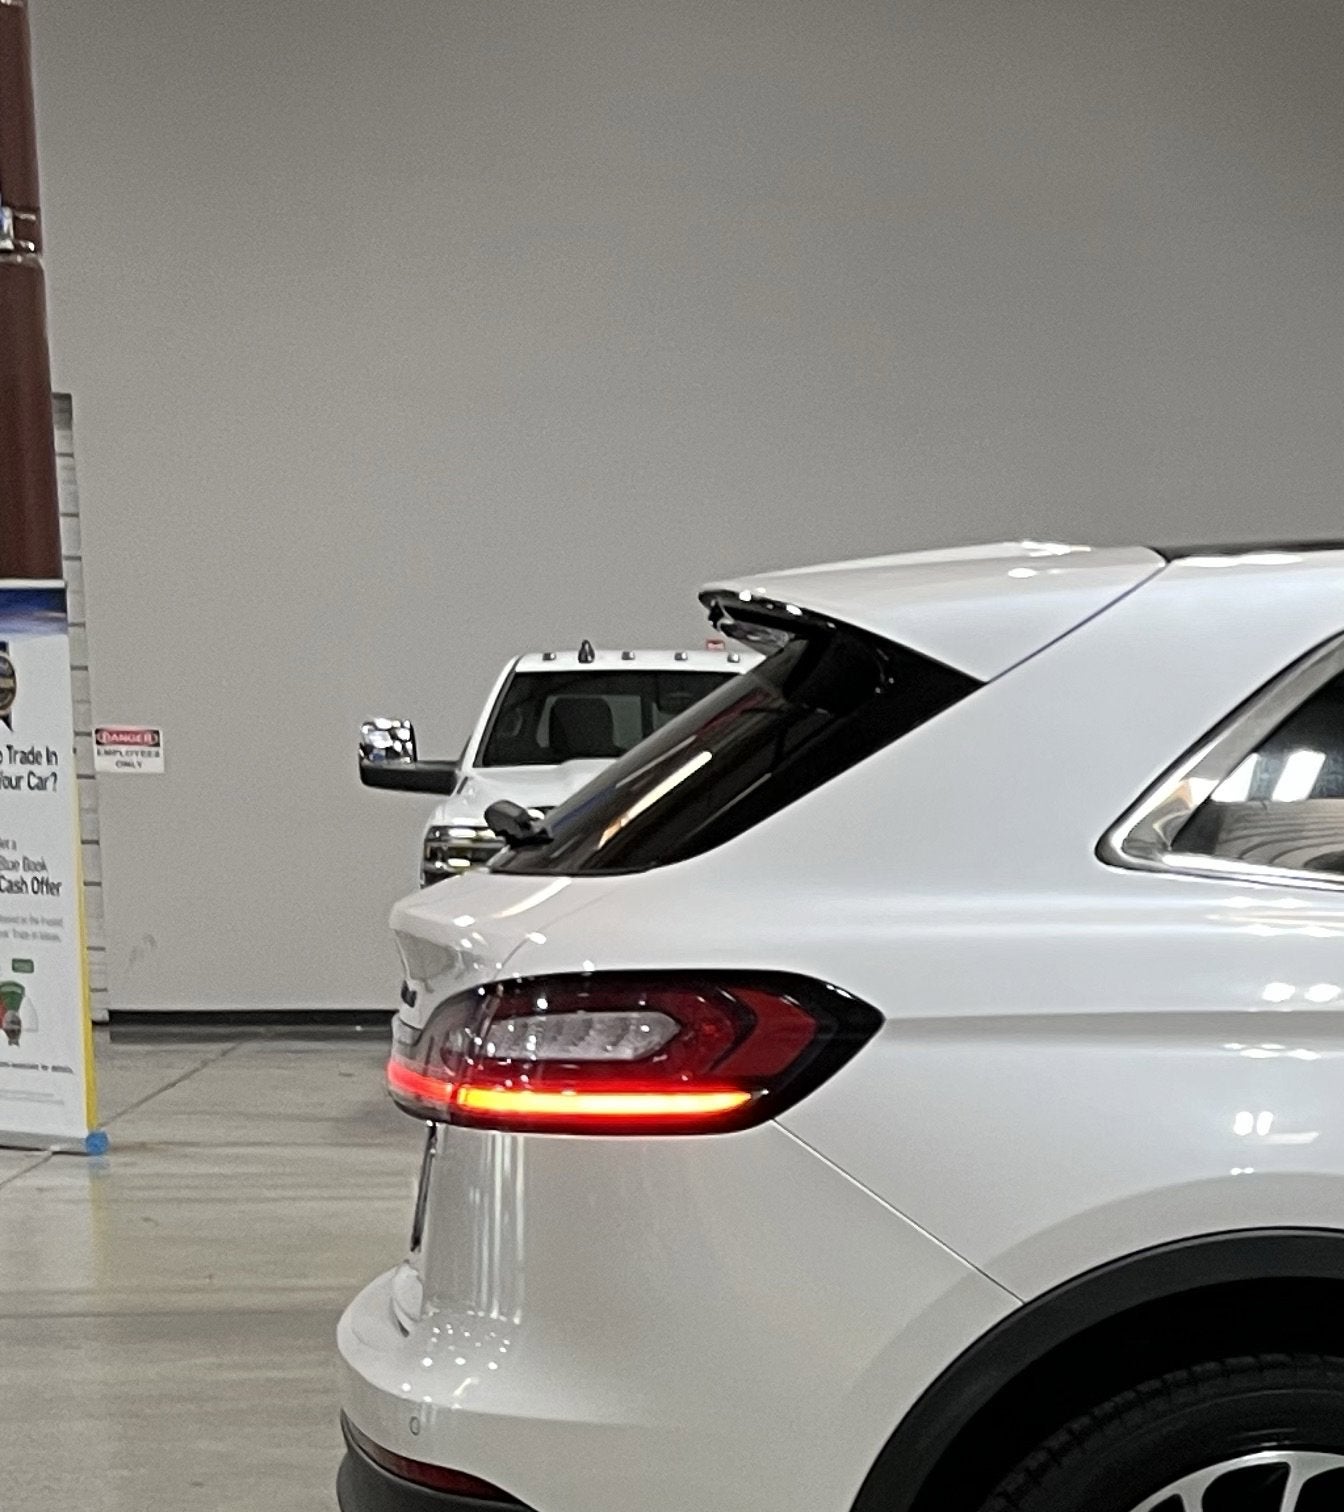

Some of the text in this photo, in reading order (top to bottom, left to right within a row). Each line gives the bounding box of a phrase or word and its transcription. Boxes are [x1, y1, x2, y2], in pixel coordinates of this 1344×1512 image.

[6, 743, 43, 766] Trade
[45, 744, 59, 766] In
[27, 769, 58, 793] Car?
[31, 876, 62, 897] Offer
